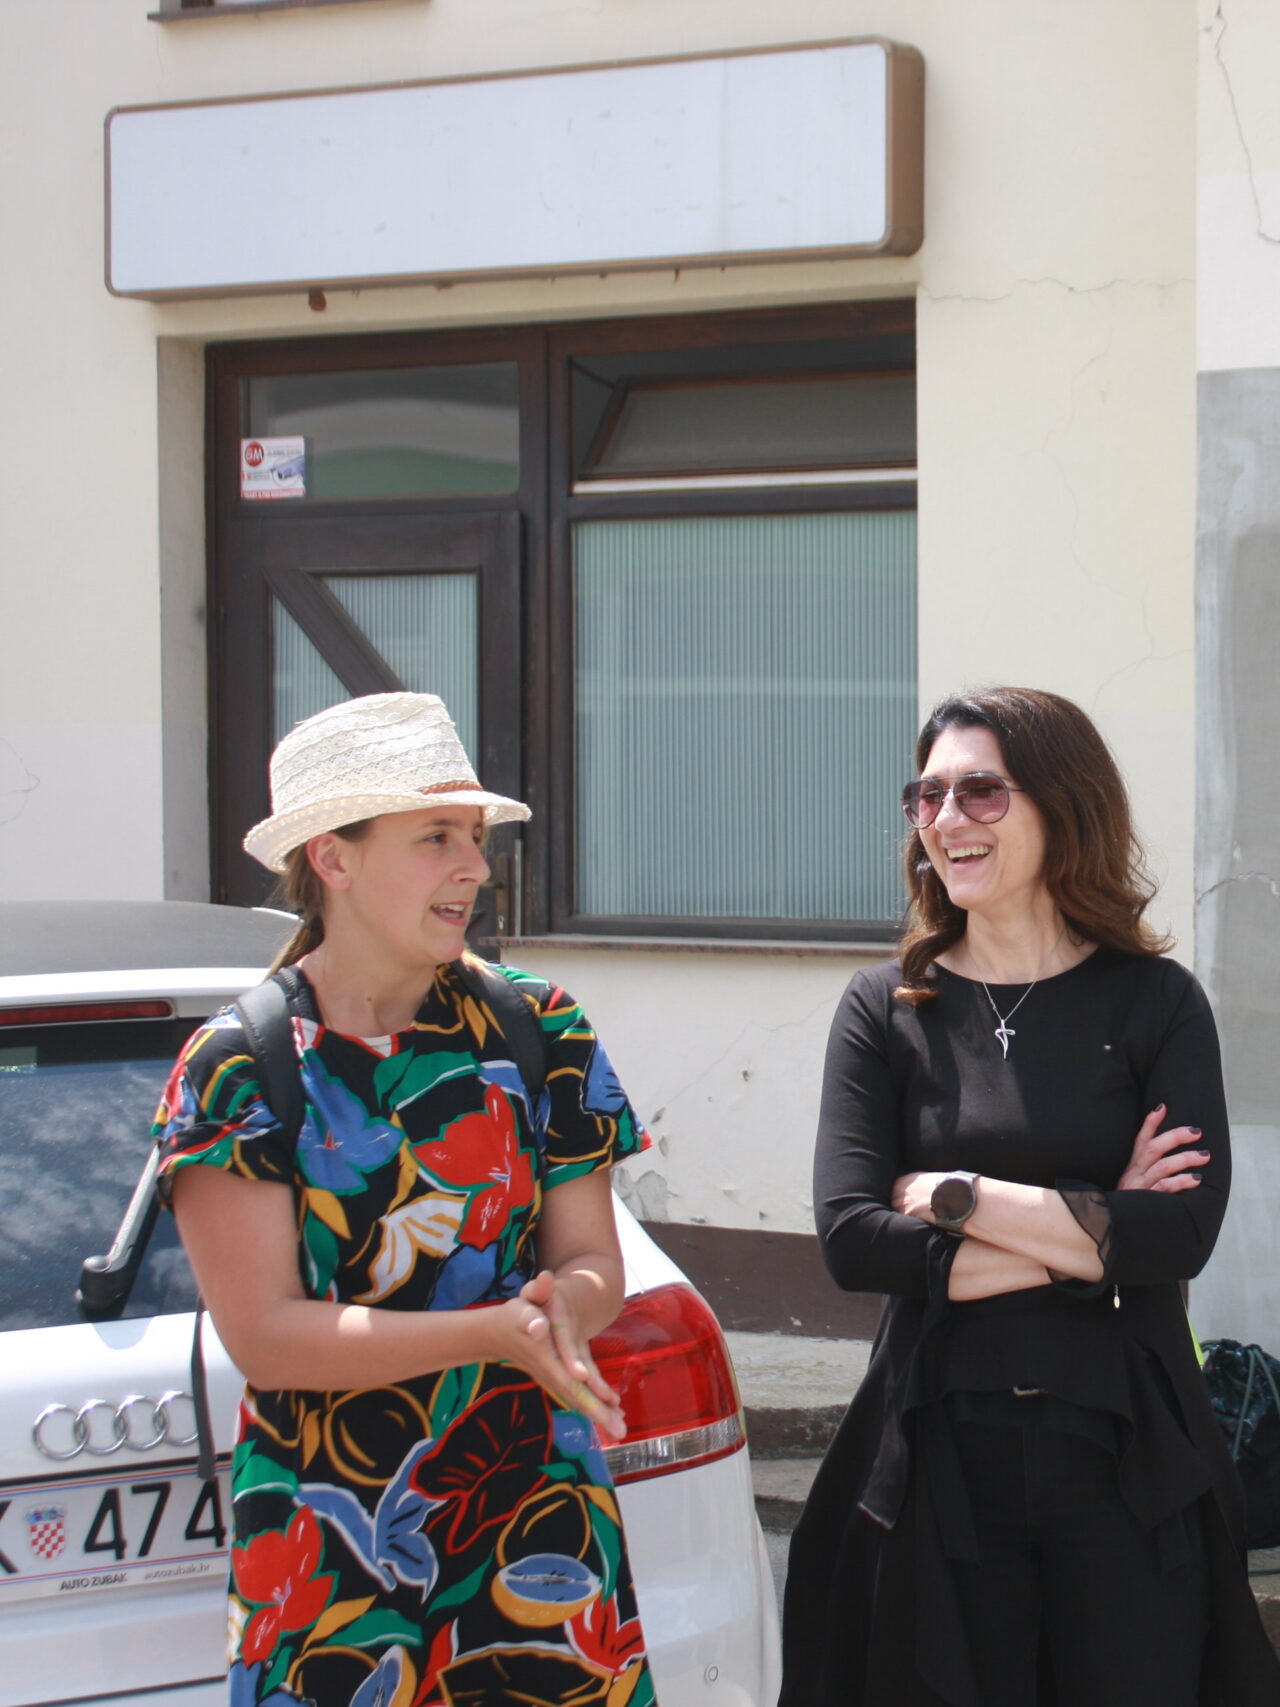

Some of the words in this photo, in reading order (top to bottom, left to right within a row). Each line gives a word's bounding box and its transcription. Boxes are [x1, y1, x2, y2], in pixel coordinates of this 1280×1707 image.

[84, 1476, 226, 1561] 474
[144, 1563, 210, 1580] autozubak.hr
[60, 1576, 90, 1591] AUTO
[92, 1572, 128, 1586] ZUBAK
